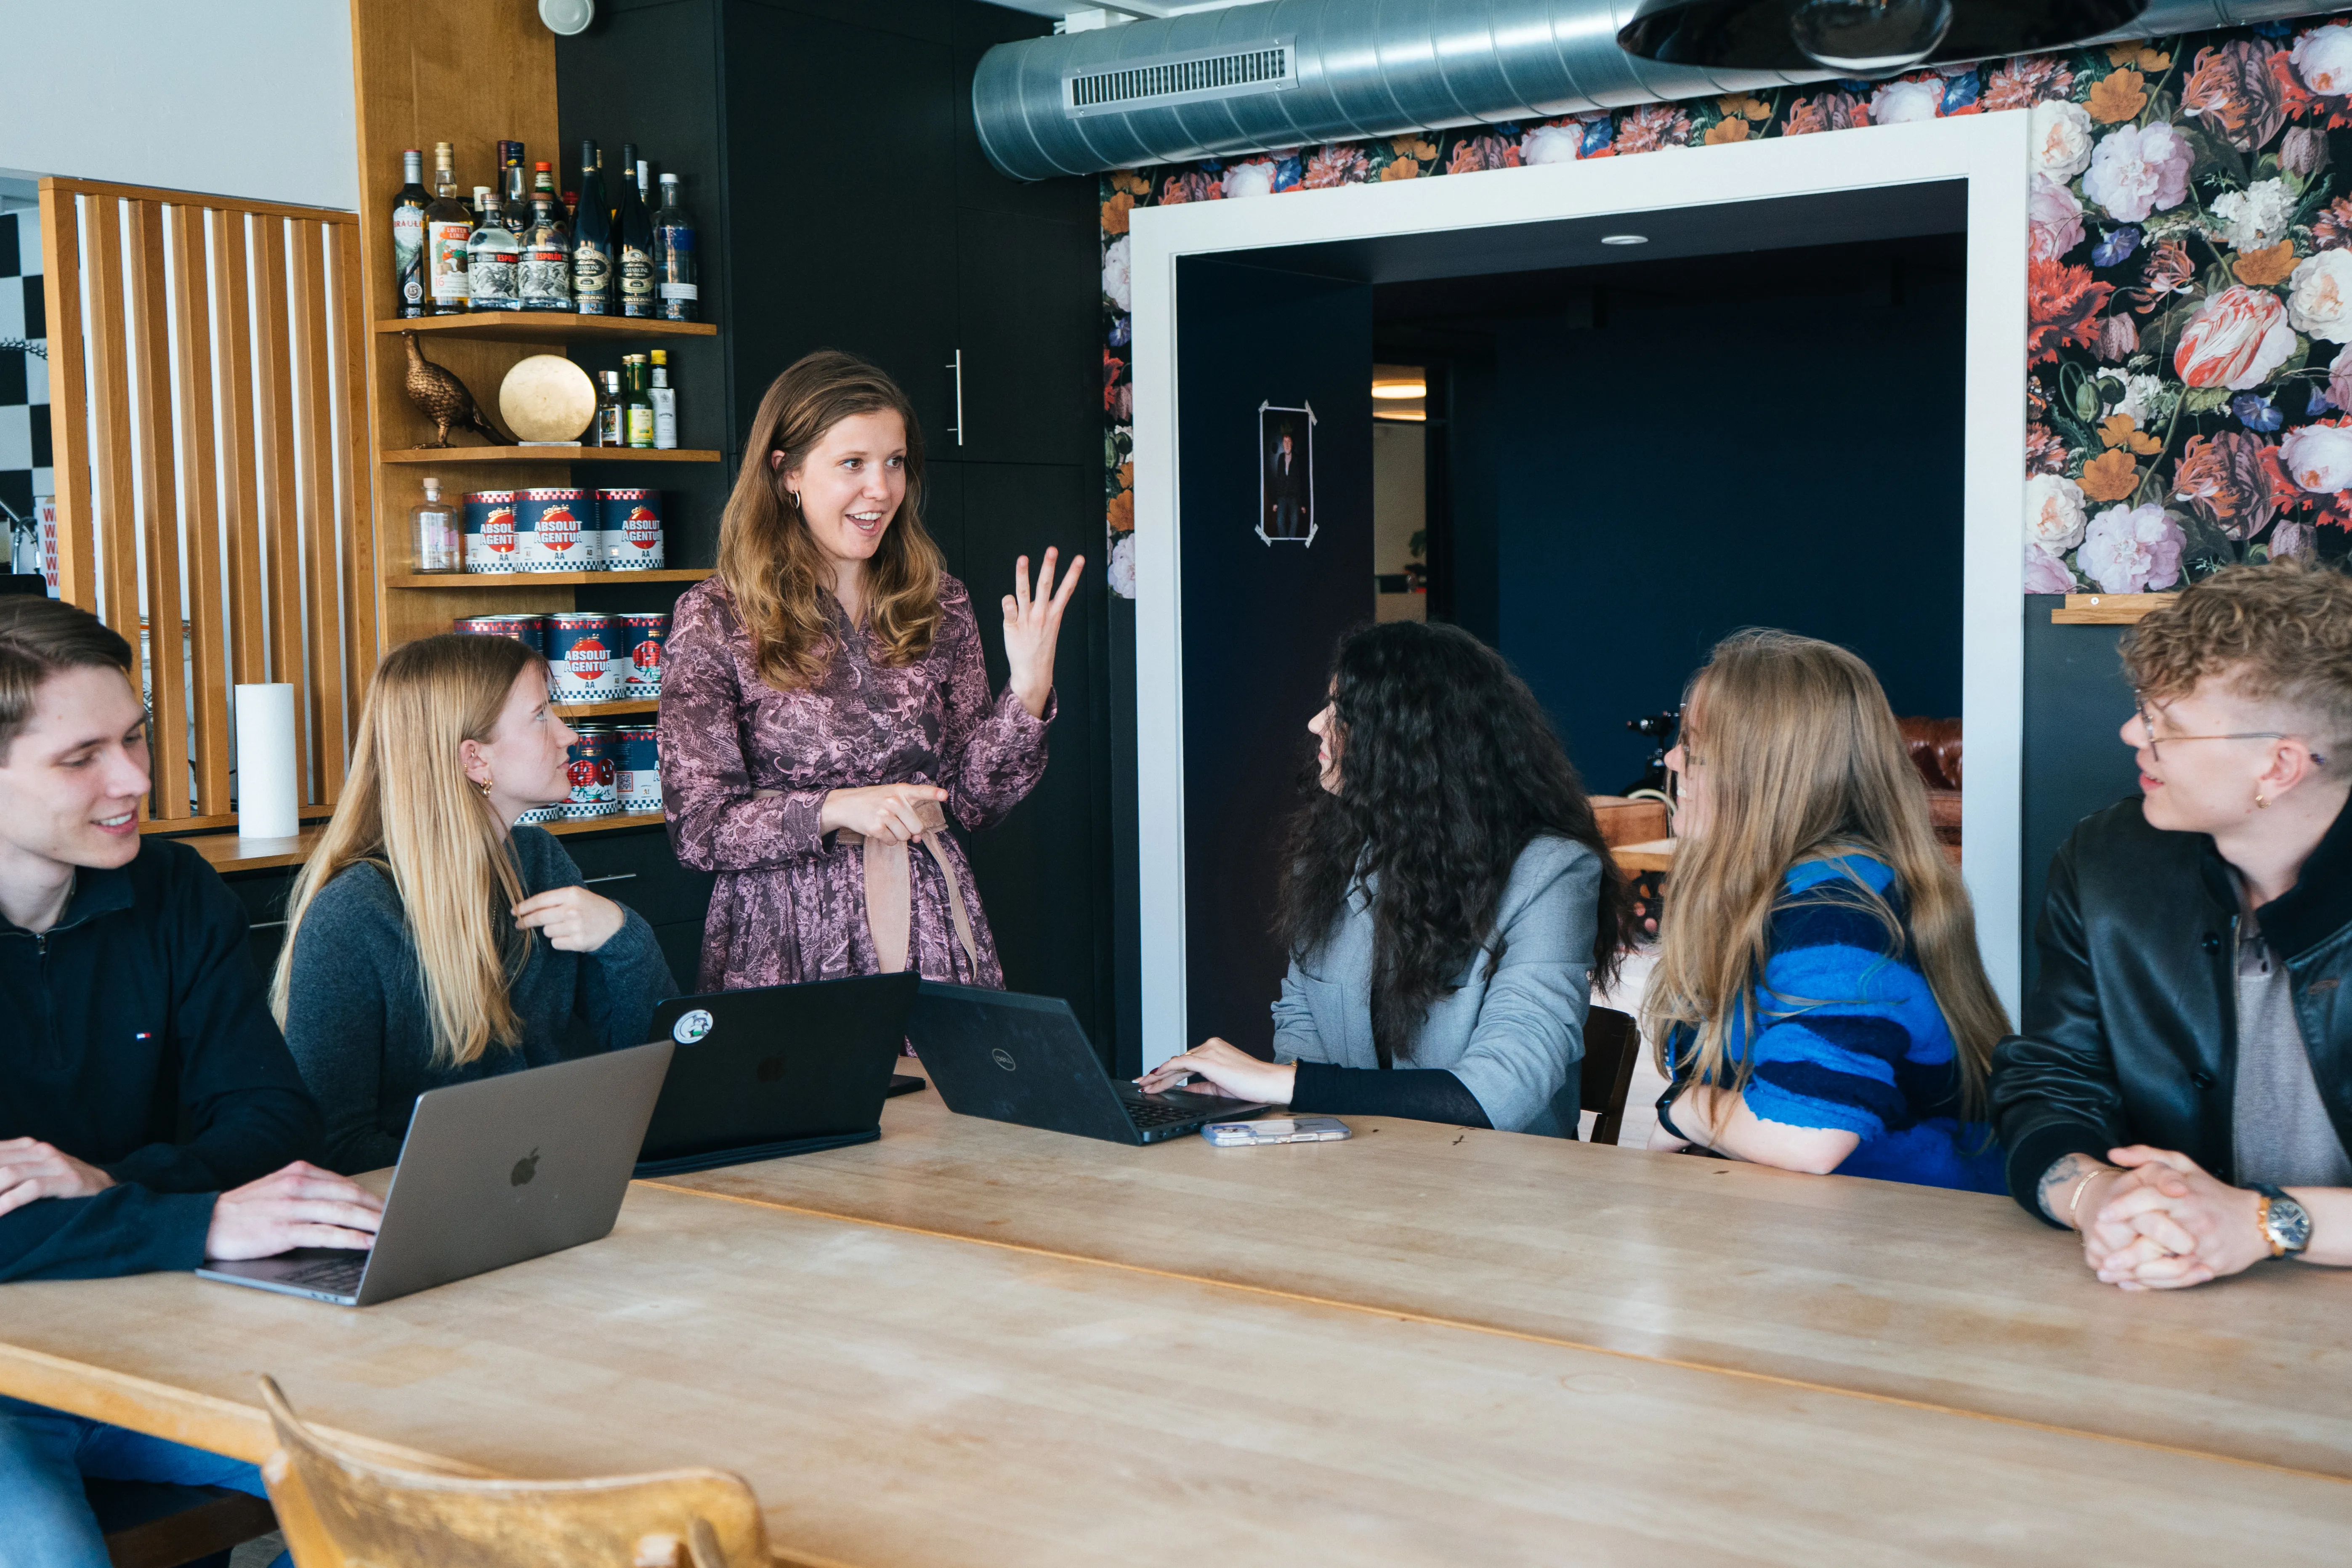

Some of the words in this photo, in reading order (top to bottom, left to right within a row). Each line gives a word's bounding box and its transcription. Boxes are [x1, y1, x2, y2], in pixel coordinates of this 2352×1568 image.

[435, 277, 444, 286] 16
[43, 508, 56, 522] W
[534, 521, 582, 532] ABSOLUT
[622, 520, 660, 530] ABSOLUT
[44, 524, 57, 538] W
[622, 531, 660, 542] AGENTUR
[534, 532, 582, 543] AGENTUR
[45, 540, 58, 554] W
[46, 557, 58, 570] W
[46, 573, 59, 586] W
[564, 650, 611, 661] ABSOLUT
[564, 661, 611, 672] AGENTUR
[996, 1055, 1013, 1064] DELL
